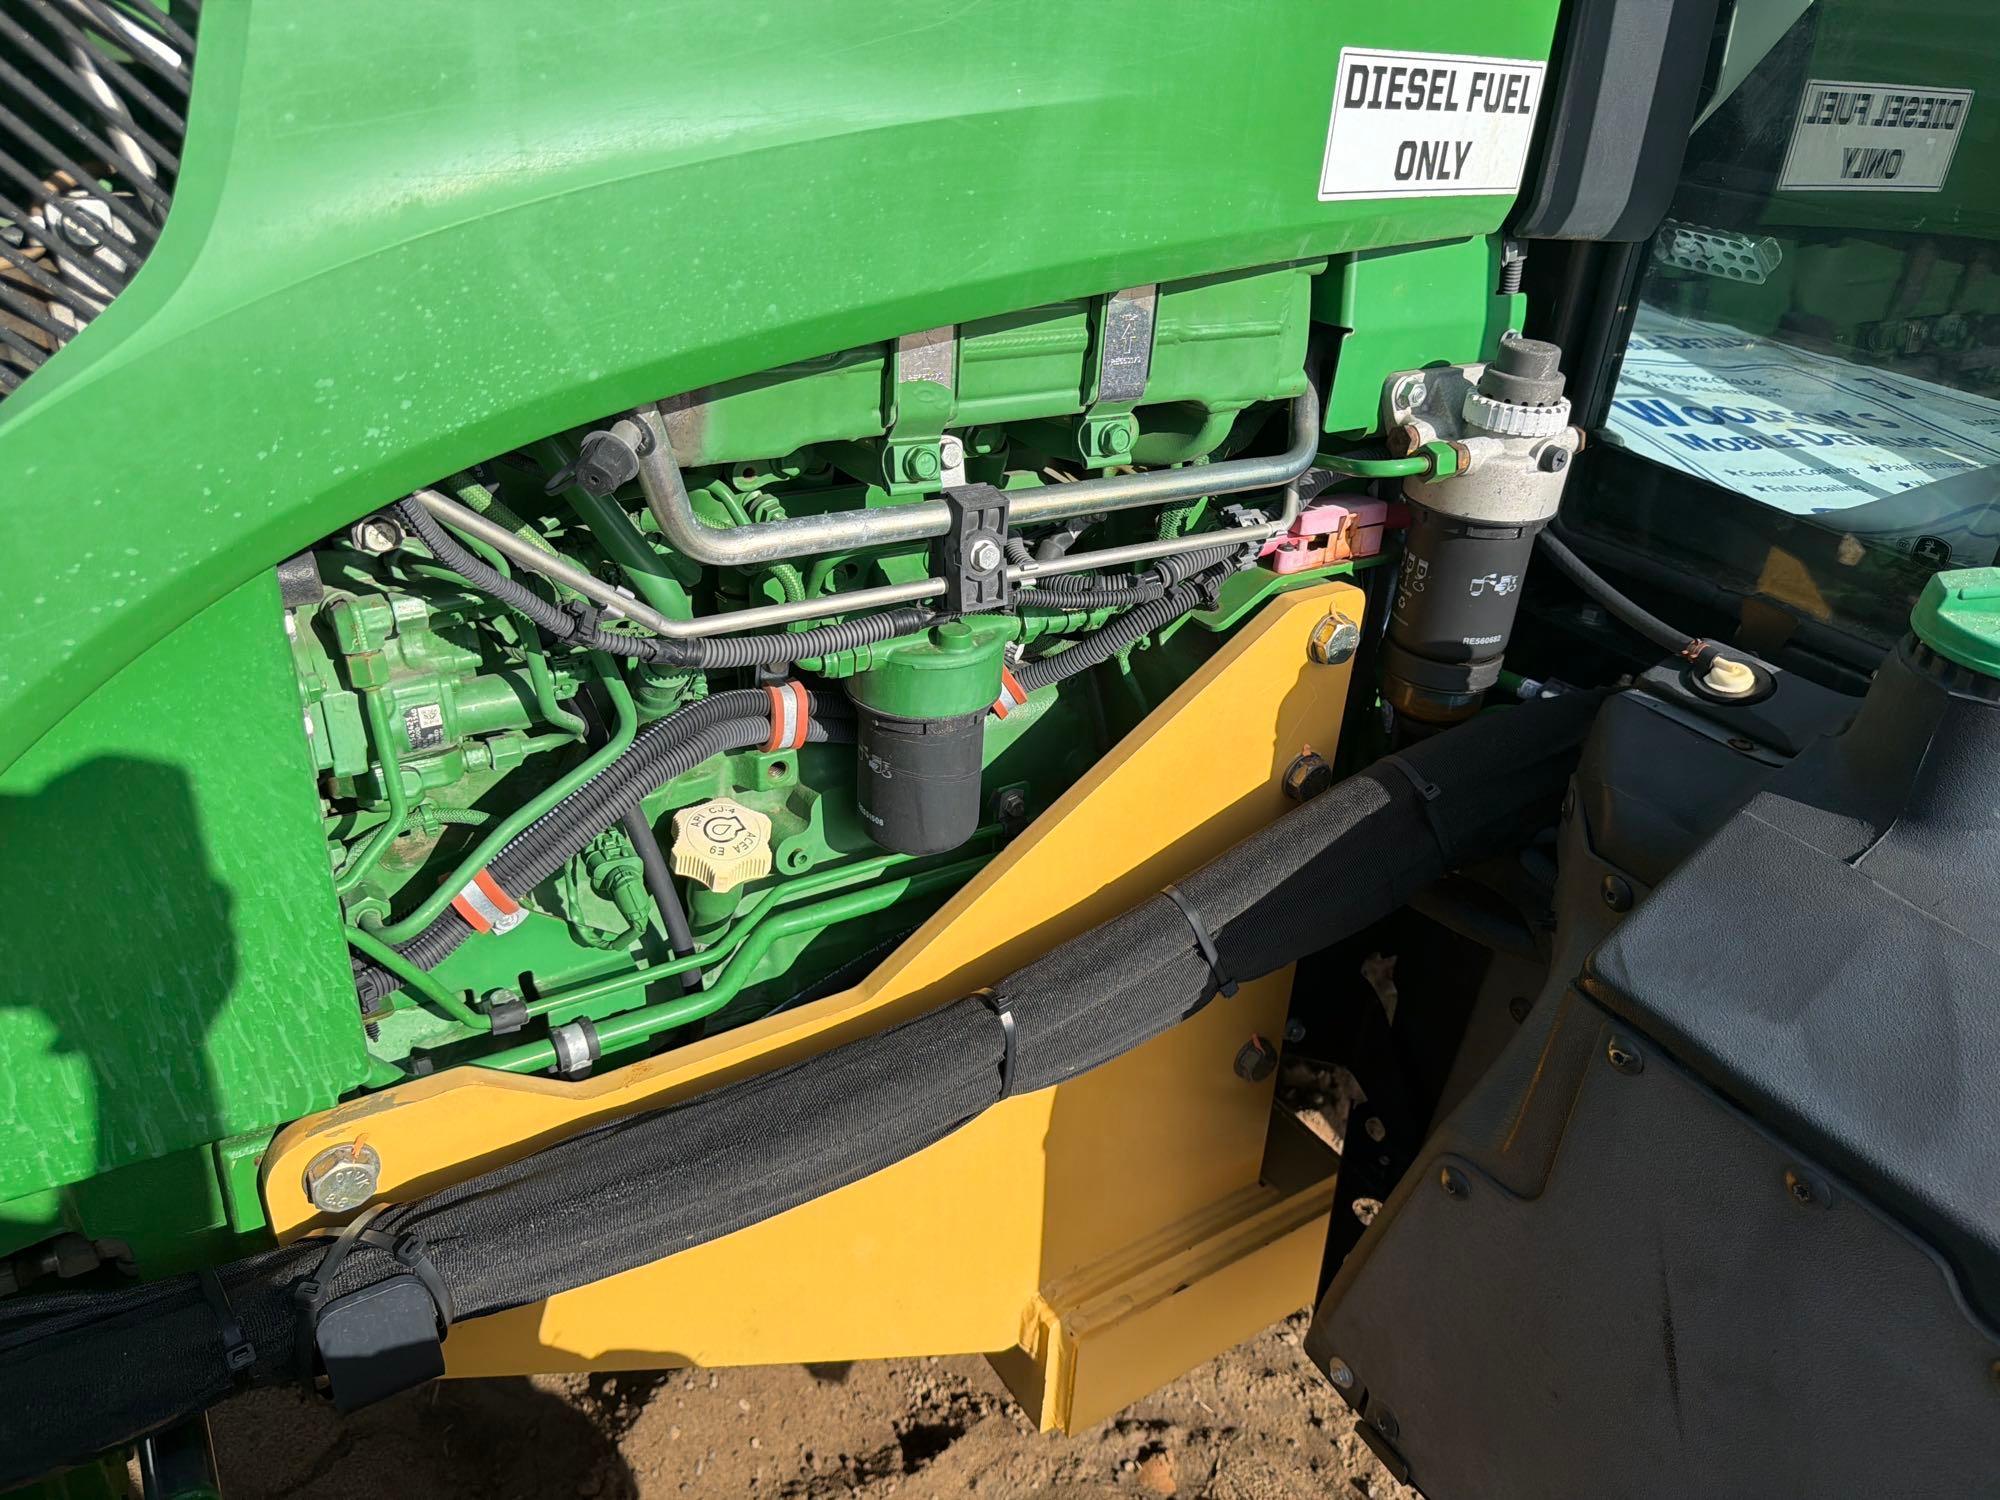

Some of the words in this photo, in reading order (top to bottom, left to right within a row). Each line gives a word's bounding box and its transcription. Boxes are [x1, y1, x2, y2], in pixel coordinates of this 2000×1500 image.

[1343, 64, 1458, 112] DIESEL
[1466, 71, 1531, 114] FUEL
[1394, 140, 1473, 181] ONLY
[1664, 430, 1807, 452] MOBILE
[690, 813, 706, 828] API
[732, 831, 757, 854] ACEA
